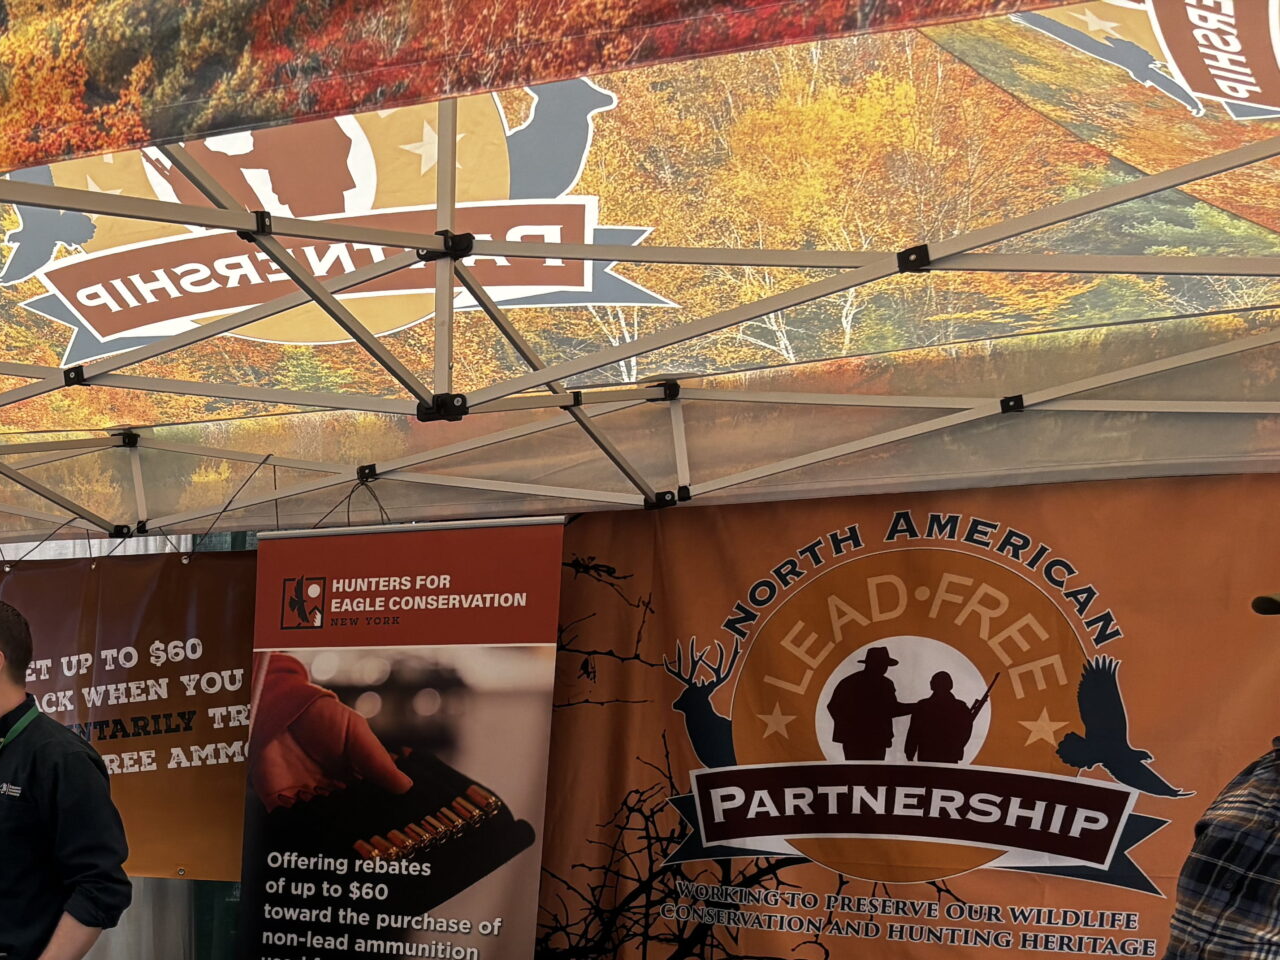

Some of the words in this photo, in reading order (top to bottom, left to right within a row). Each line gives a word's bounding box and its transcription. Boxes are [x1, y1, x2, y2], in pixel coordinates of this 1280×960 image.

[332, 576, 411, 592] HUNTERS
[416, 575, 450, 590] FOR
[721, 524, 865, 642] NORTH
[884, 509, 1123, 649] AMERICAN
[331, 598, 384, 612] EAGLE
[389, 593, 527, 610] CONSERVATION
[331, 617, 359, 626] NEW
[366, 616, 400, 625] YORK
[25, 659, 52, 682] ET
[61, 653, 92, 676] UP
[101, 646, 138, 670] TO
[150, 638, 202, 666] $60
[82, 678, 168, 707] WHEN
[180, 669, 244, 696] YOU
[710, 786, 1110, 839] PARTNERSHIP
[267, 852, 348, 874] Offering
[355, 857, 431, 876] rebates
[265, 878, 285, 893] of
[291, 881, 315, 898] up
[322, 881, 342, 897] to
[349, 881, 388, 900] $60
[264, 904, 331, 923] toward
[339, 908, 370, 925] the
[377, 913, 471, 933] purchase
[479, 917, 502, 935] of
[676, 881, 781, 908] WORKING
[785, 889, 819, 909] TO
[825, 894, 939, 919] PRESERVE
[945, 902, 1001, 924] OUR
[1007, 905, 1138, 931] WILDLIFE
[263, 931, 348, 950] non-lead
[355, 939, 478, 960] ammunition
[659, 902, 823, 934] CONSERVATION
[827, 916, 881, 939] AND
[886, 922, 1012, 949] HUNTING
[1018, 933, 1156, 958] HERITAGE
